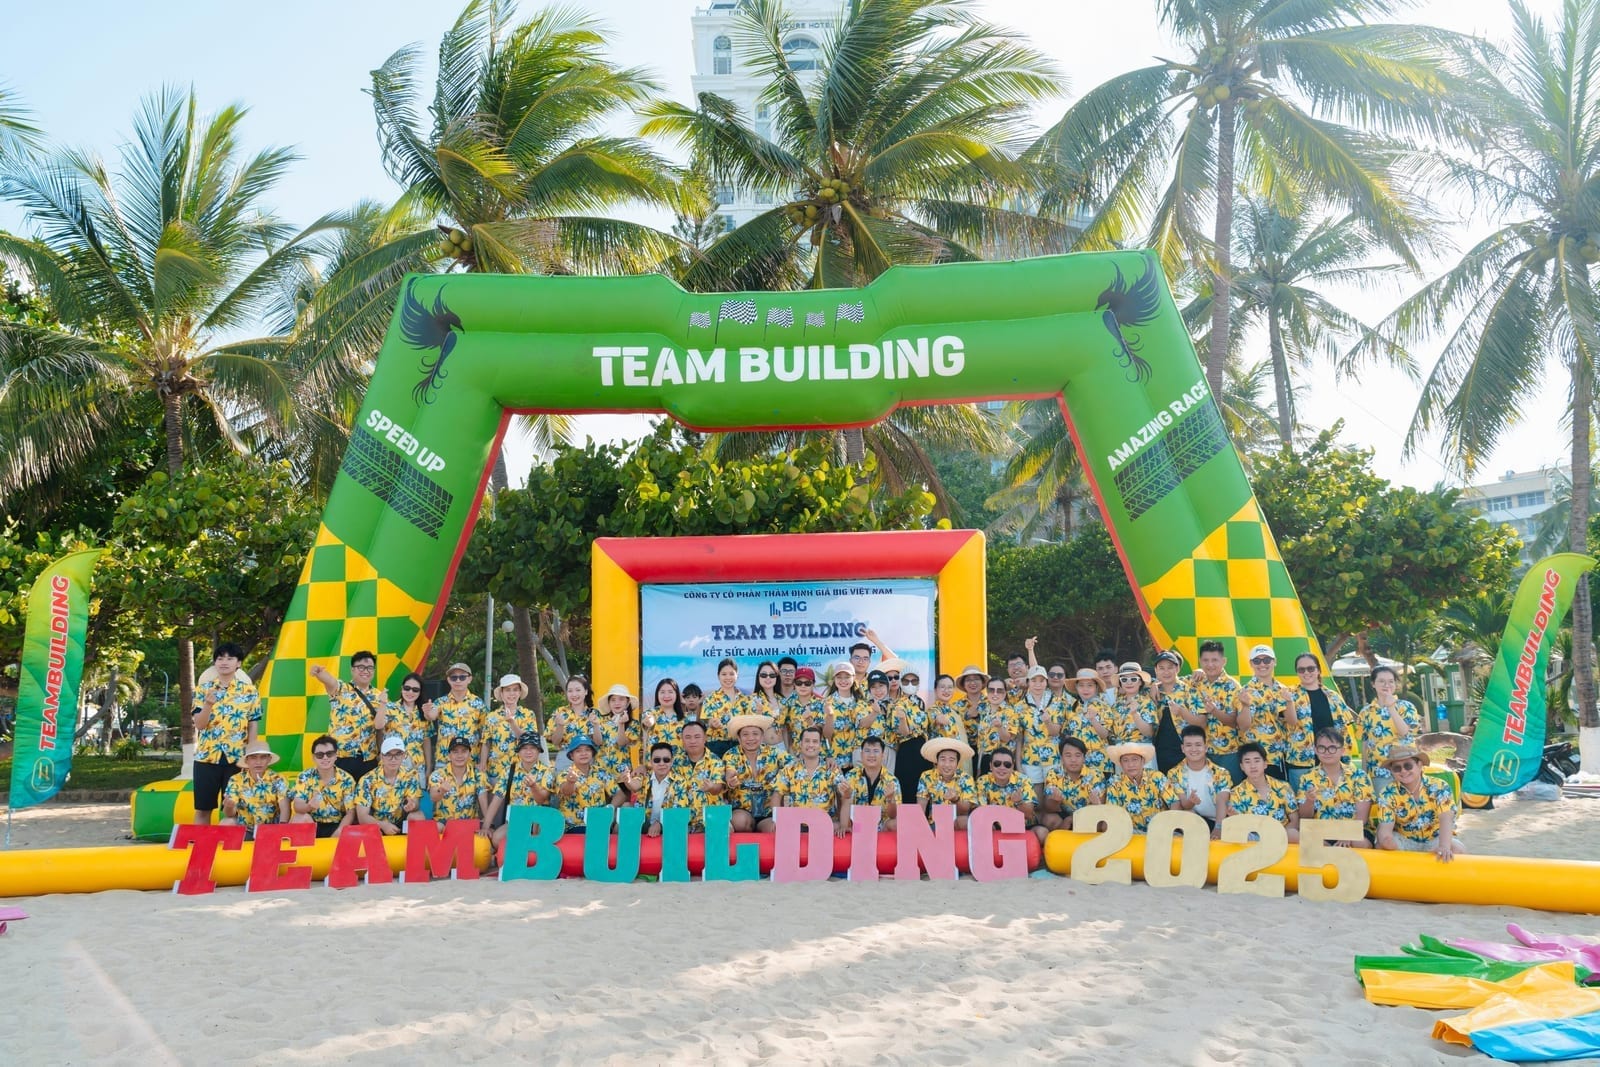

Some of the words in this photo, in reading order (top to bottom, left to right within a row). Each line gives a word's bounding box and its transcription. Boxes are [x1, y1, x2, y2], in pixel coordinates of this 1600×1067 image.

[592, 346, 726, 388] TEAM
[739, 335, 966, 382] BUILDING
[365, 409, 420, 457] SPEED
[416, 447, 446, 473] UP
[1106, 410, 1173, 472] AMAZING
[1169, 379, 1209, 417] RACE
[683, 590, 708, 599] CÔNG
[709, 591, 721, 599] TY
[815, 587, 831, 597] GIÁ
[833, 588, 848, 596] BIG
[849, 586, 869, 597] VIỆT
[782, 600, 808, 612] BIG
[702, 645, 722, 657] KẾT
[725, 645, 745, 657] SỨC
[747, 647, 779, 658] MẠNH
[788, 643, 807, 655] NỐI
[809, 644, 846, 655] THÀNH
[711, 624, 767, 641] TEAM
[773, 622, 868, 640] BUILDING
[1503, 568, 1560, 746] TEAMBUILDING
[40, 575, 70, 751] TEAMBUILDING
[168, 818, 482, 895] TEAM
[498, 804, 1030, 883] BUILDING
[1070, 804, 1371, 903] 2025
